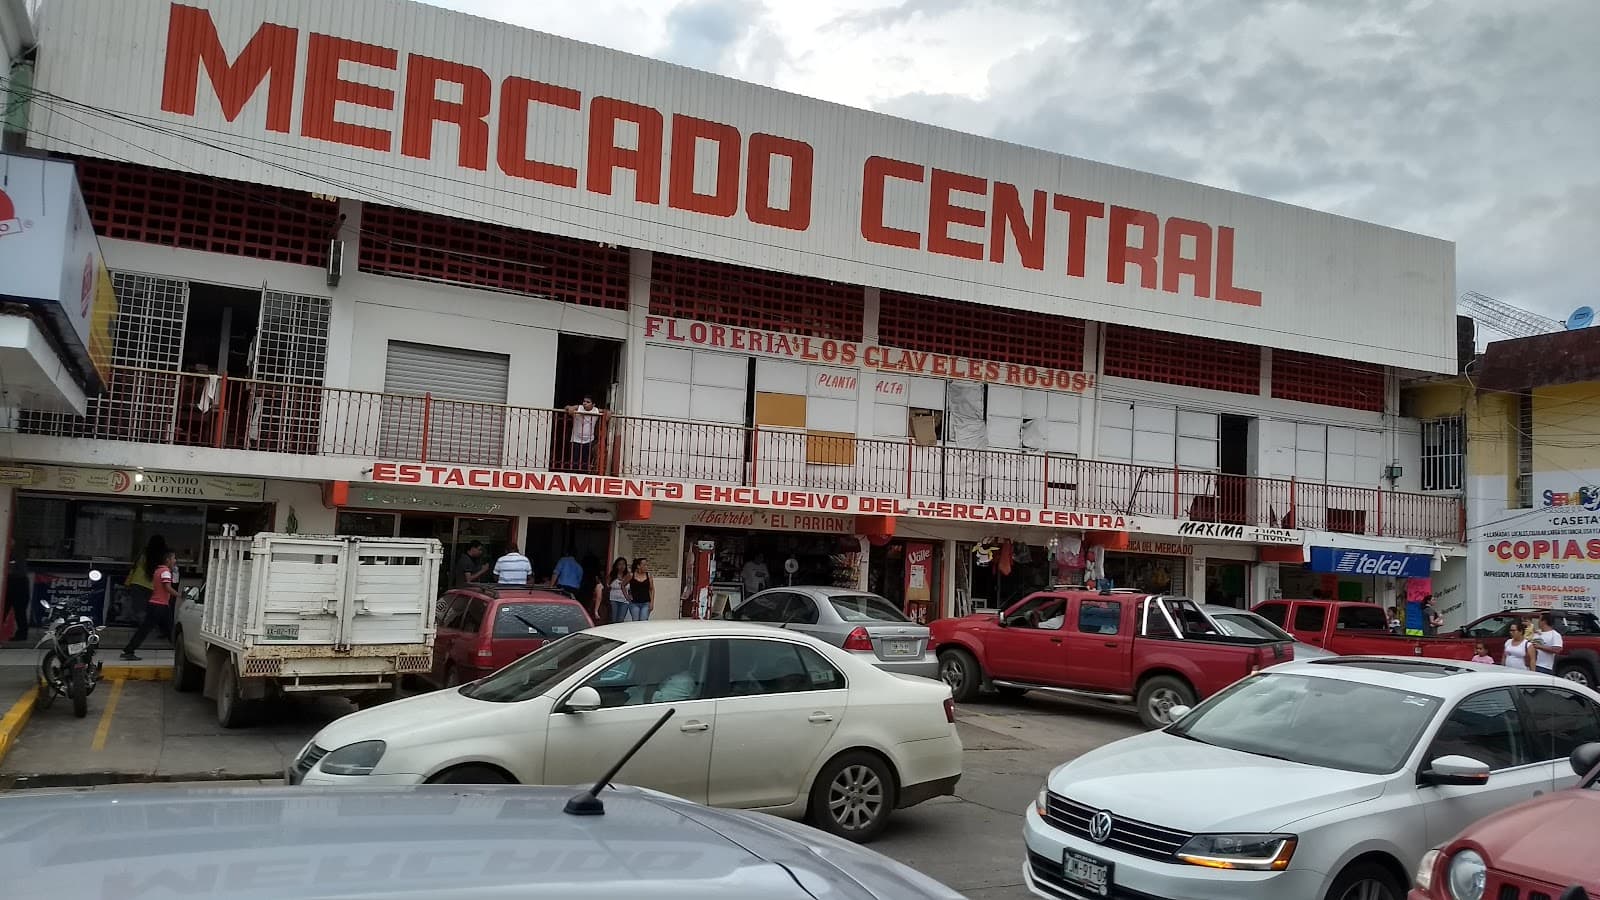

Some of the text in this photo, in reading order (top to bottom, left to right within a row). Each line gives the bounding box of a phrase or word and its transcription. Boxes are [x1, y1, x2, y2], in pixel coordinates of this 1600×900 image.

[161, 2, 1262, 307] MERCADO CENTRAL
[644, 315, 793, 356] FLORERIA
[863, 346, 1000, 383] CLAVELES
[133, 483, 149, 492] DE
[153, 484, 205, 496] LOTERIA
[372, 462, 1125, 529] ESTACIONAMIENTO EXCLUSIVO DEL MERCADO CENTRA
[1178, 522, 1243, 539] MAXIMA
[1553, 516, 1598, 525] CASETA
[1155, 541, 1194, 555] MERCADO
[1496, 538, 1600, 560] COPIAS
[1356, 553, 1410, 576] telcel
